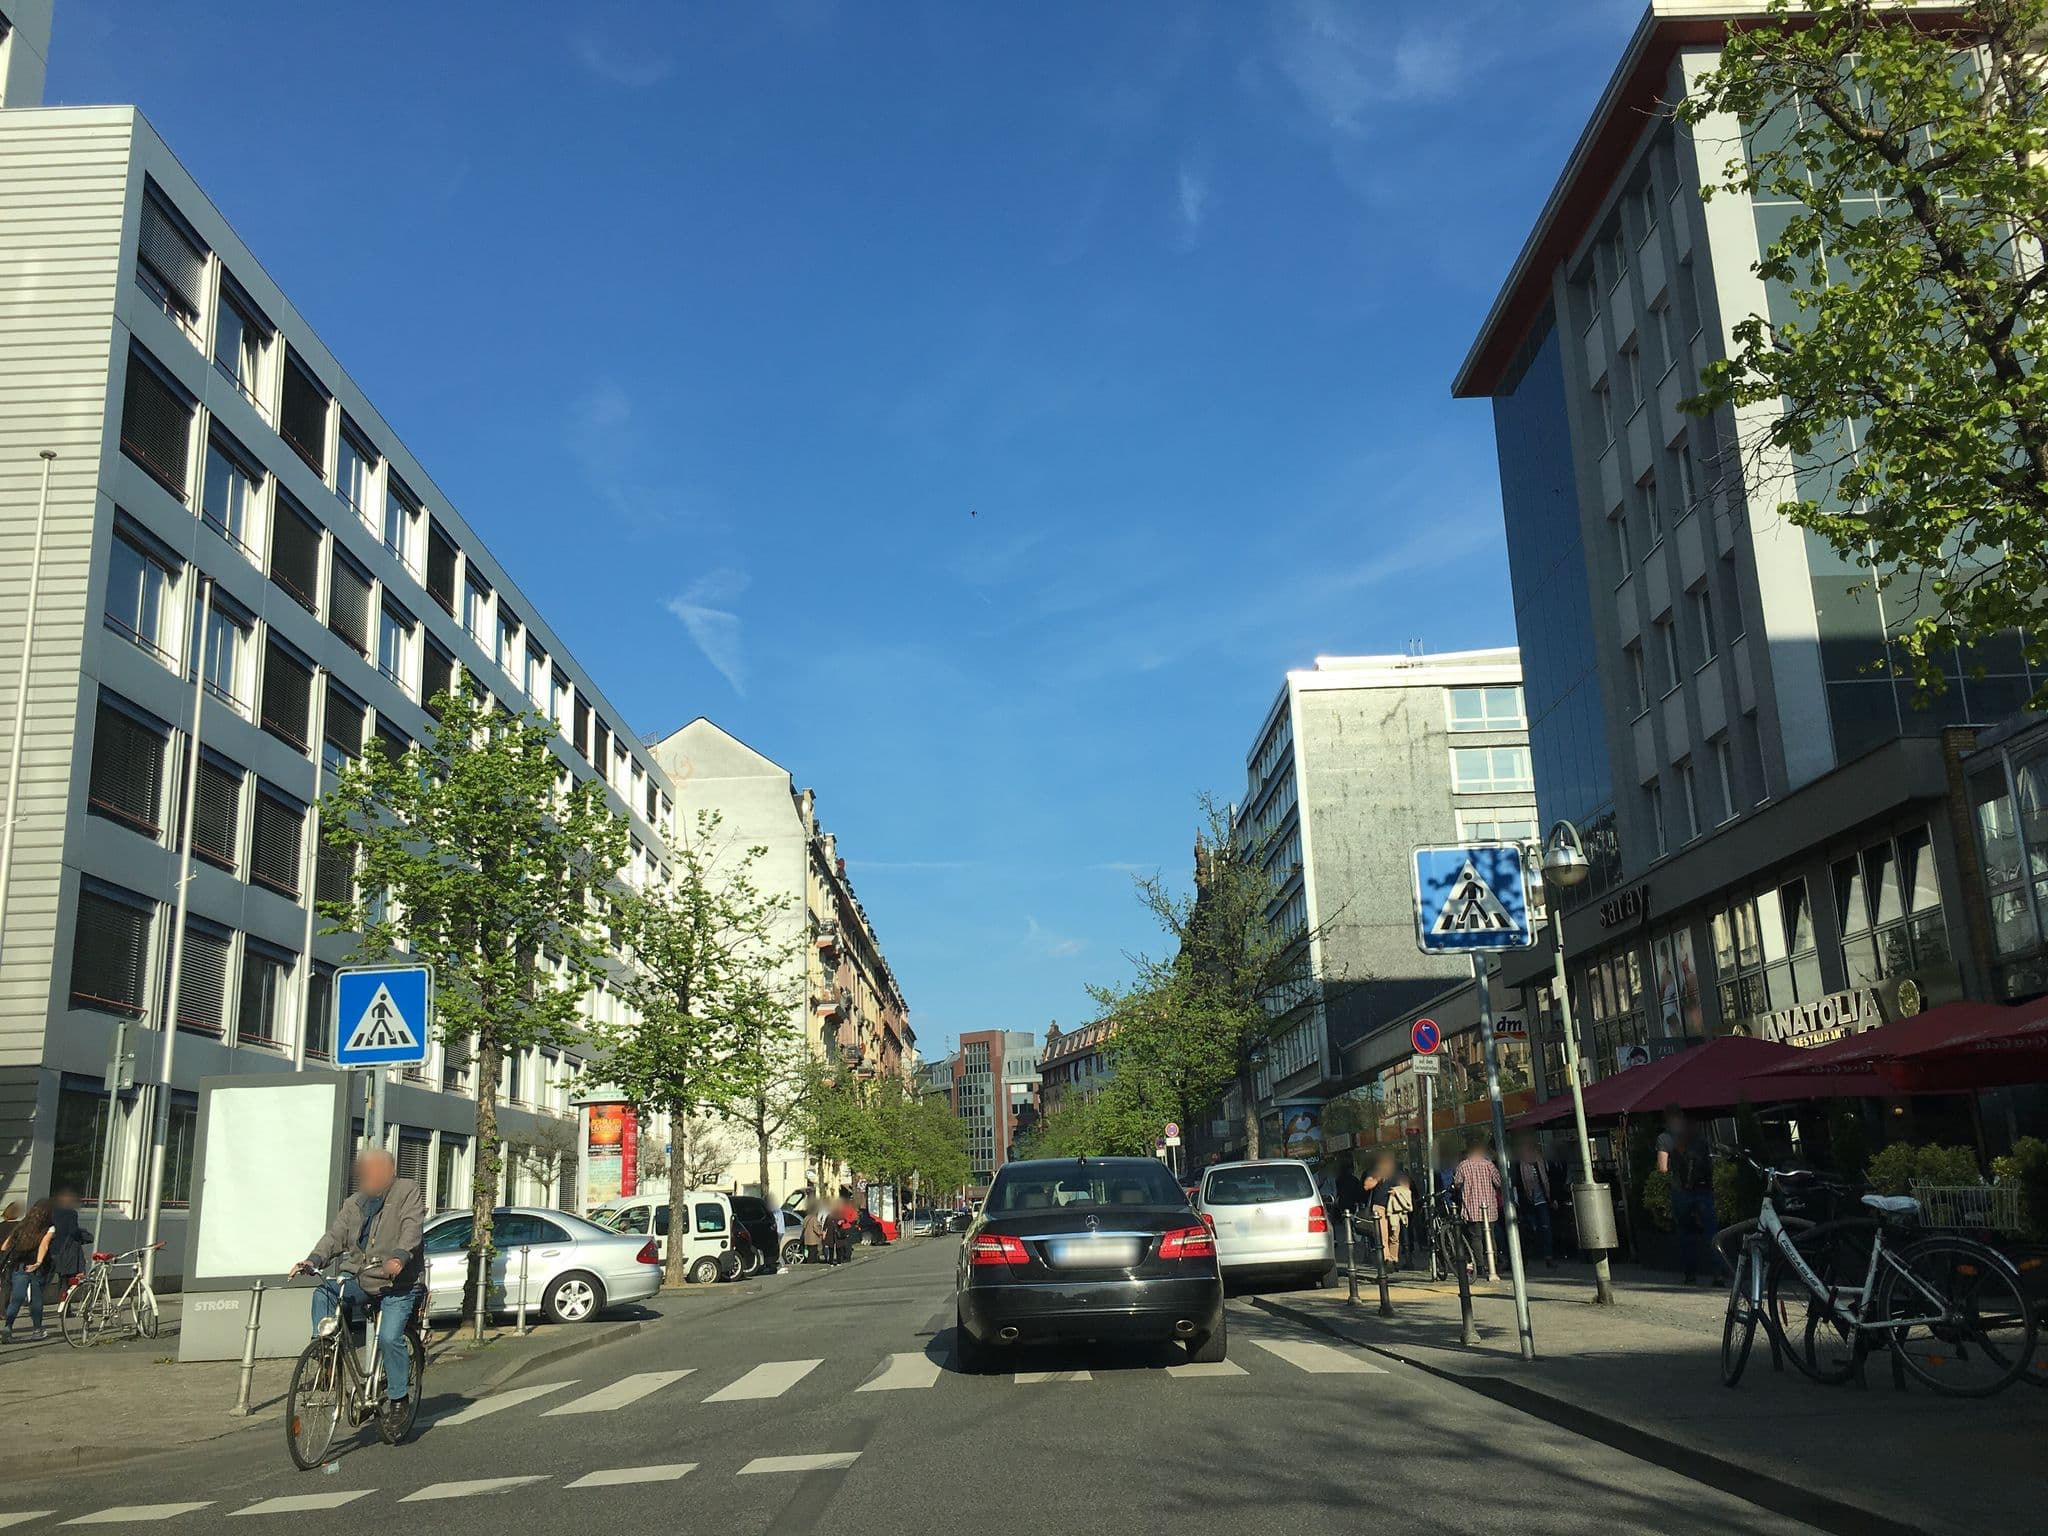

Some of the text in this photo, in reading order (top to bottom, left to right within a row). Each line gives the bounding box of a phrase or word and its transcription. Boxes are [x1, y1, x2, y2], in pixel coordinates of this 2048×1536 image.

[1496, 1016, 1522, 1032] dm
[1762, 987, 1883, 1044] ANATOLIA
[1793, 1027, 1847, 1048] RESTAURANT
